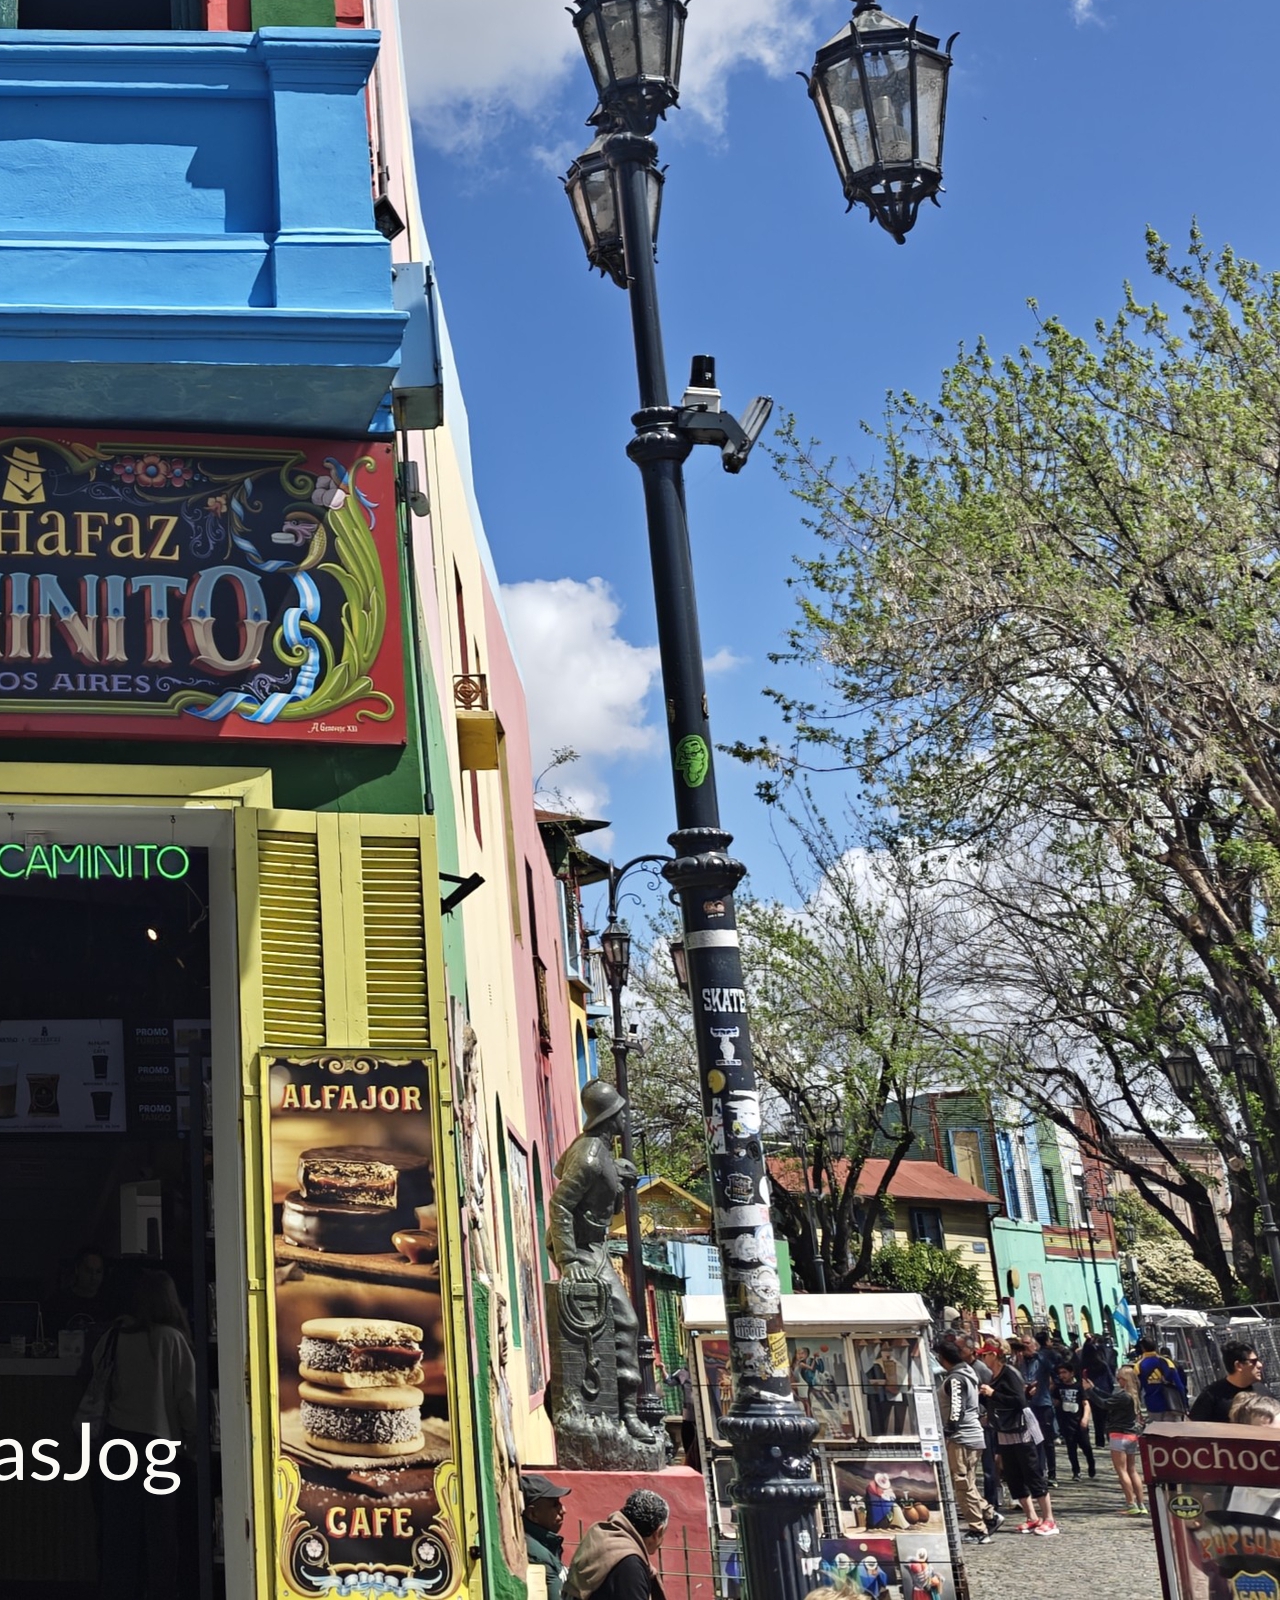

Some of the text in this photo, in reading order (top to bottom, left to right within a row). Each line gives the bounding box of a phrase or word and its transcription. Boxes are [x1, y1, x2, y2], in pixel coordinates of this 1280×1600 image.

[49, 674, 152, 694] AIRES
[135, 1027, 169, 1036] PROMO
[281, 1083, 423, 1113] ALFAJOR
[138, 1104, 172, 1113] PROMO
[326, 1507, 414, 1538] CAFE
